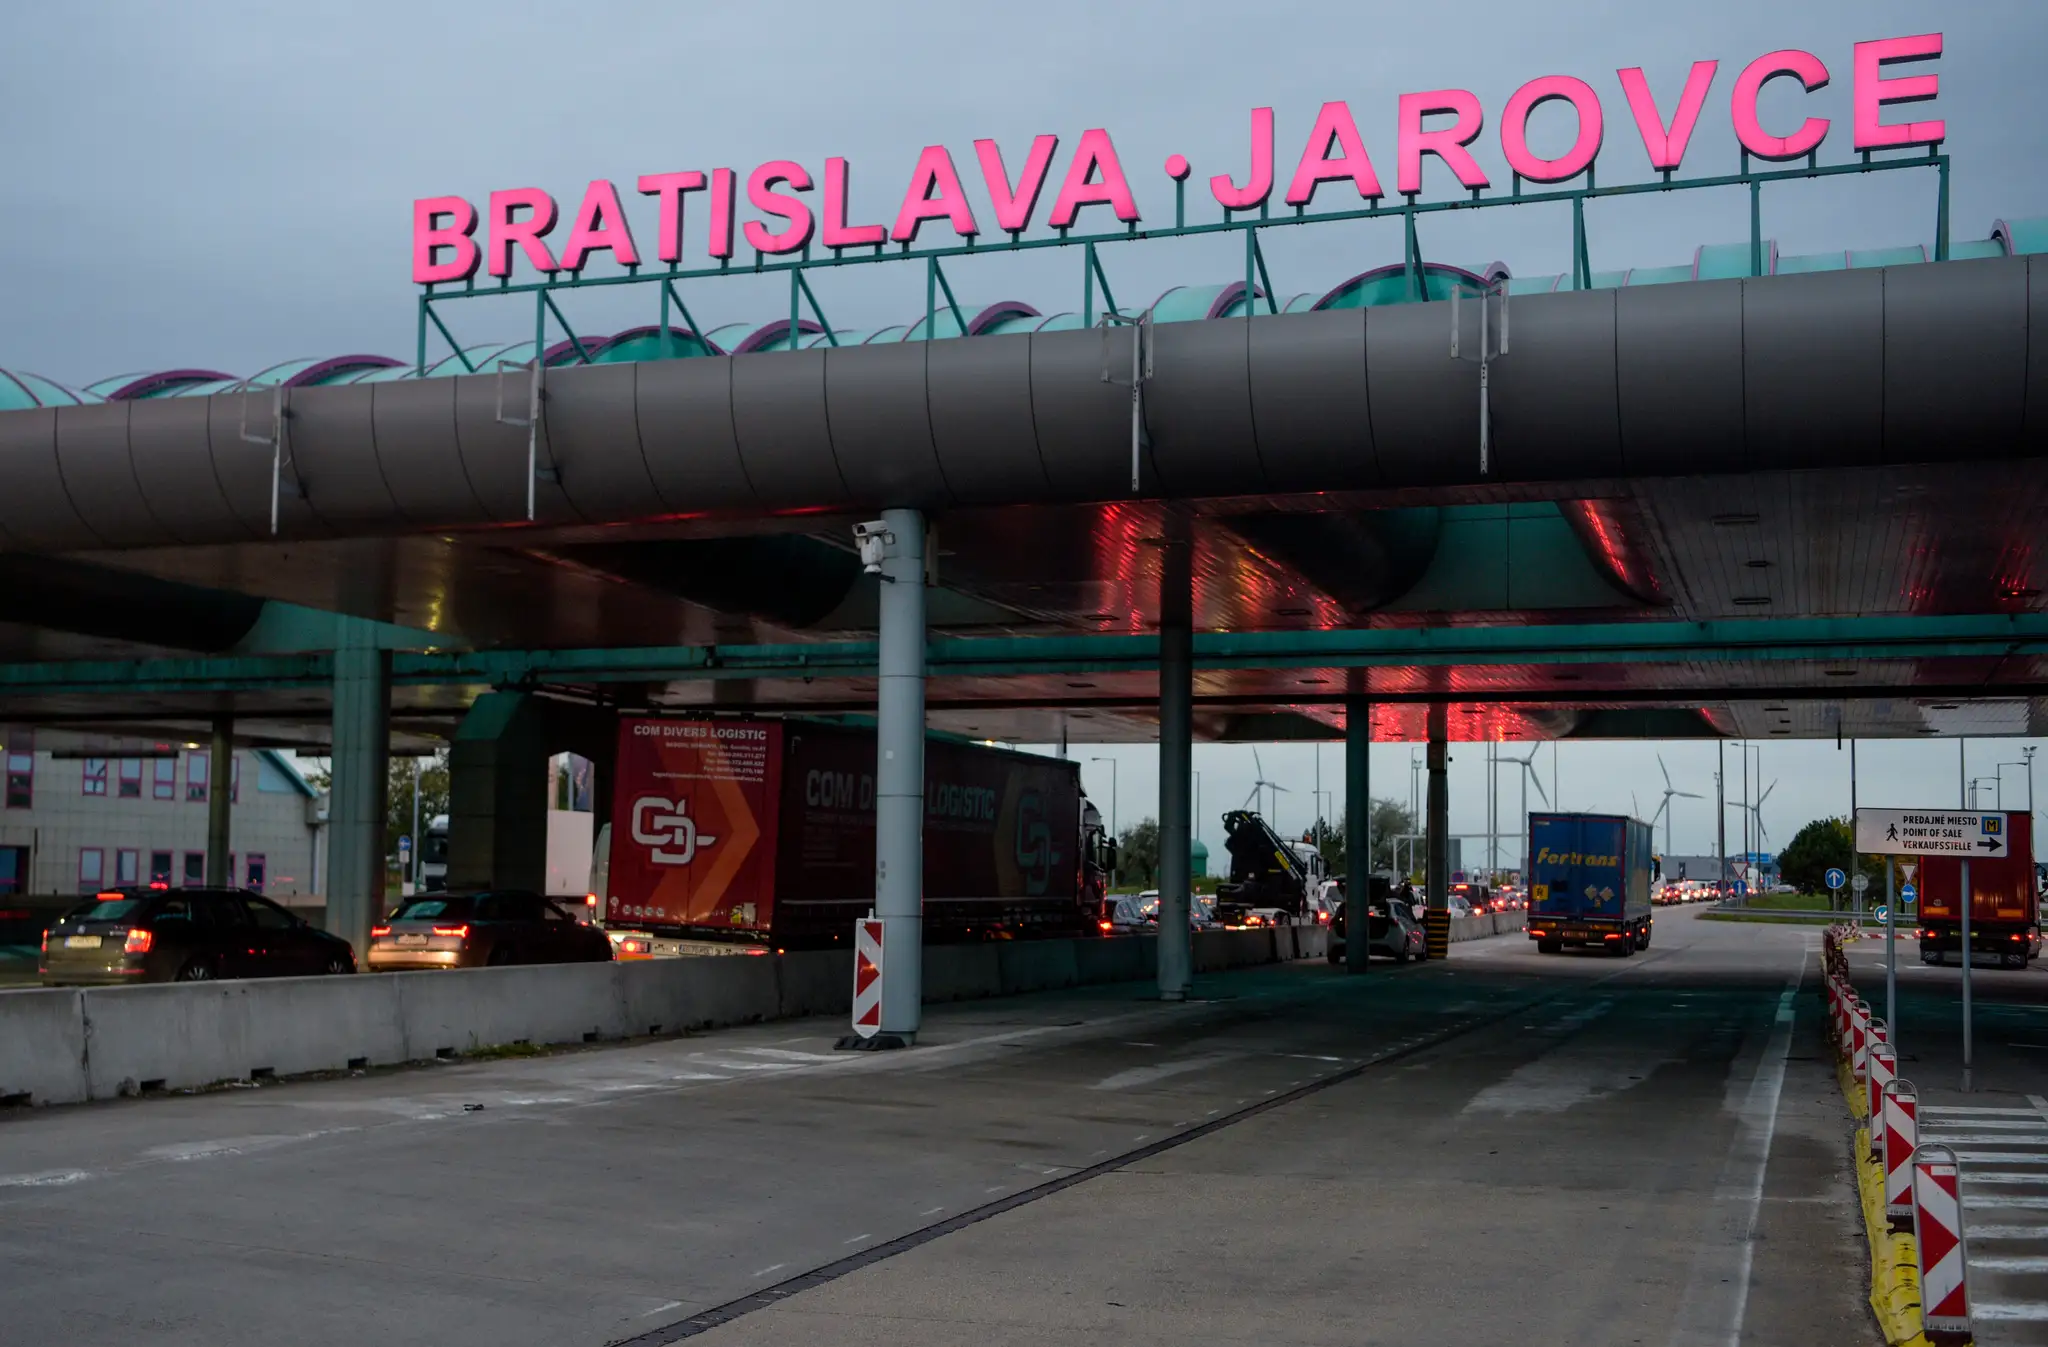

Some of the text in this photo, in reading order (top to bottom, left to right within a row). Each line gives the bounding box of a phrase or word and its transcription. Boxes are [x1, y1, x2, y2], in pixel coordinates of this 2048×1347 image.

[413, 127, 1141, 284] BRATISLAVA
[1210, 33, 1946, 210] JAROVCE
[633, 725, 767, 740] COM DIVERS LOGISTIC
[806, 769, 855, 809] COM
[927, 780, 996, 821] LOGISTIC
[1902, 814, 1978, 826] PREDAJNÉ MIESTO
[1902, 828, 1963, 838] POINT OF SALE
[1902, 840, 1972, 851] VERKAUFSSTELLE
